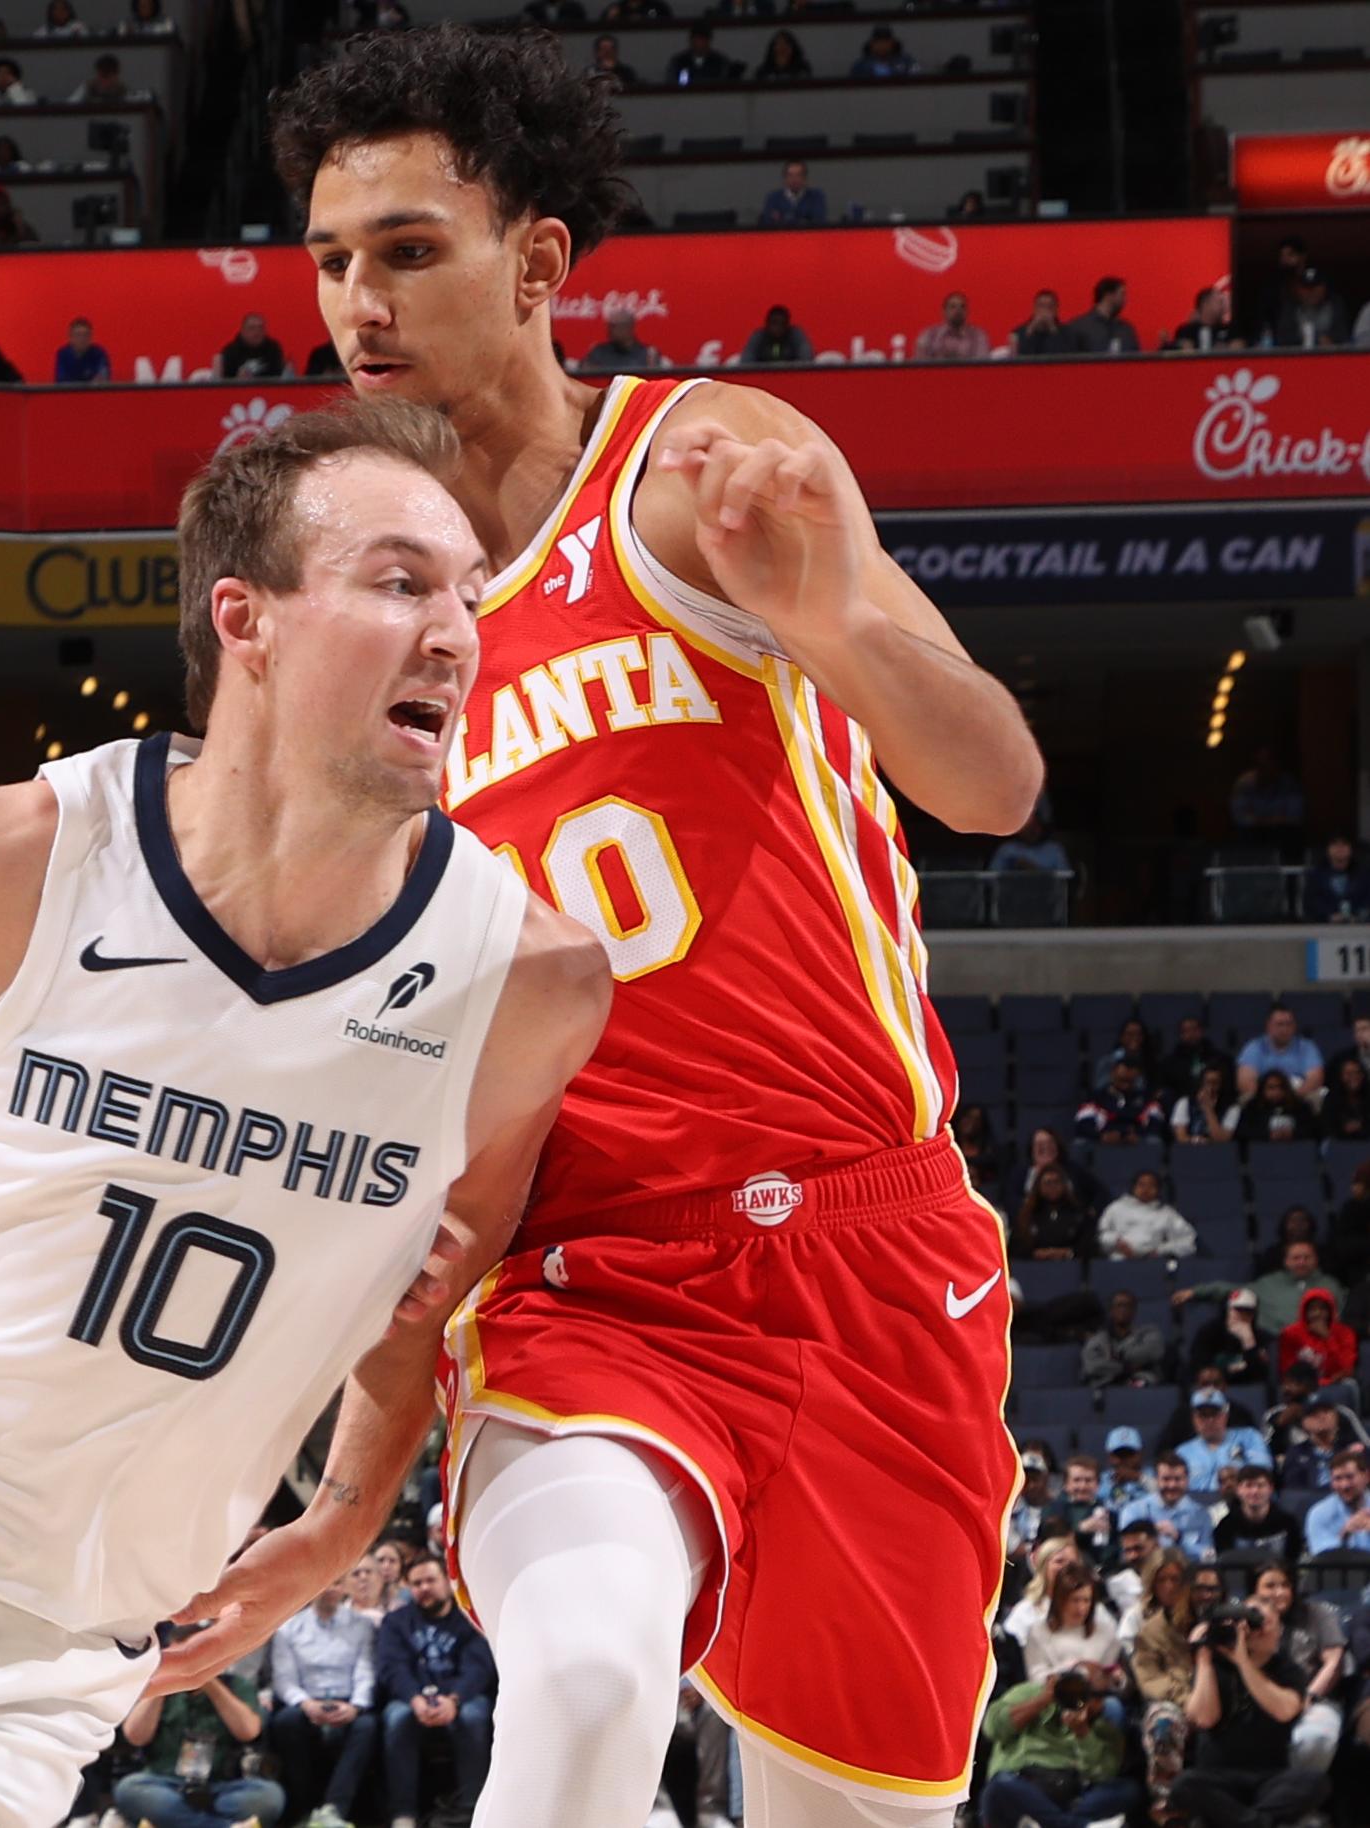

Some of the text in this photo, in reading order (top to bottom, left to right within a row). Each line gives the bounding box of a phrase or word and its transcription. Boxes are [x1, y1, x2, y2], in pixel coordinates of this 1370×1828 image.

[26, 545, 179, 621] CLUB
[892, 535, 1323, 580] COCKTAIL IN A CAN
[444, 631, 723, 812] LANTA
[492, 794, 703, 983] 0
[344, 1018, 447, 1059] Robinhood
[8, 1047, 421, 1208] MEMPHIS
[733, 1186, 802, 1211] HAWKS
[66, 1183, 276, 1381] 10
